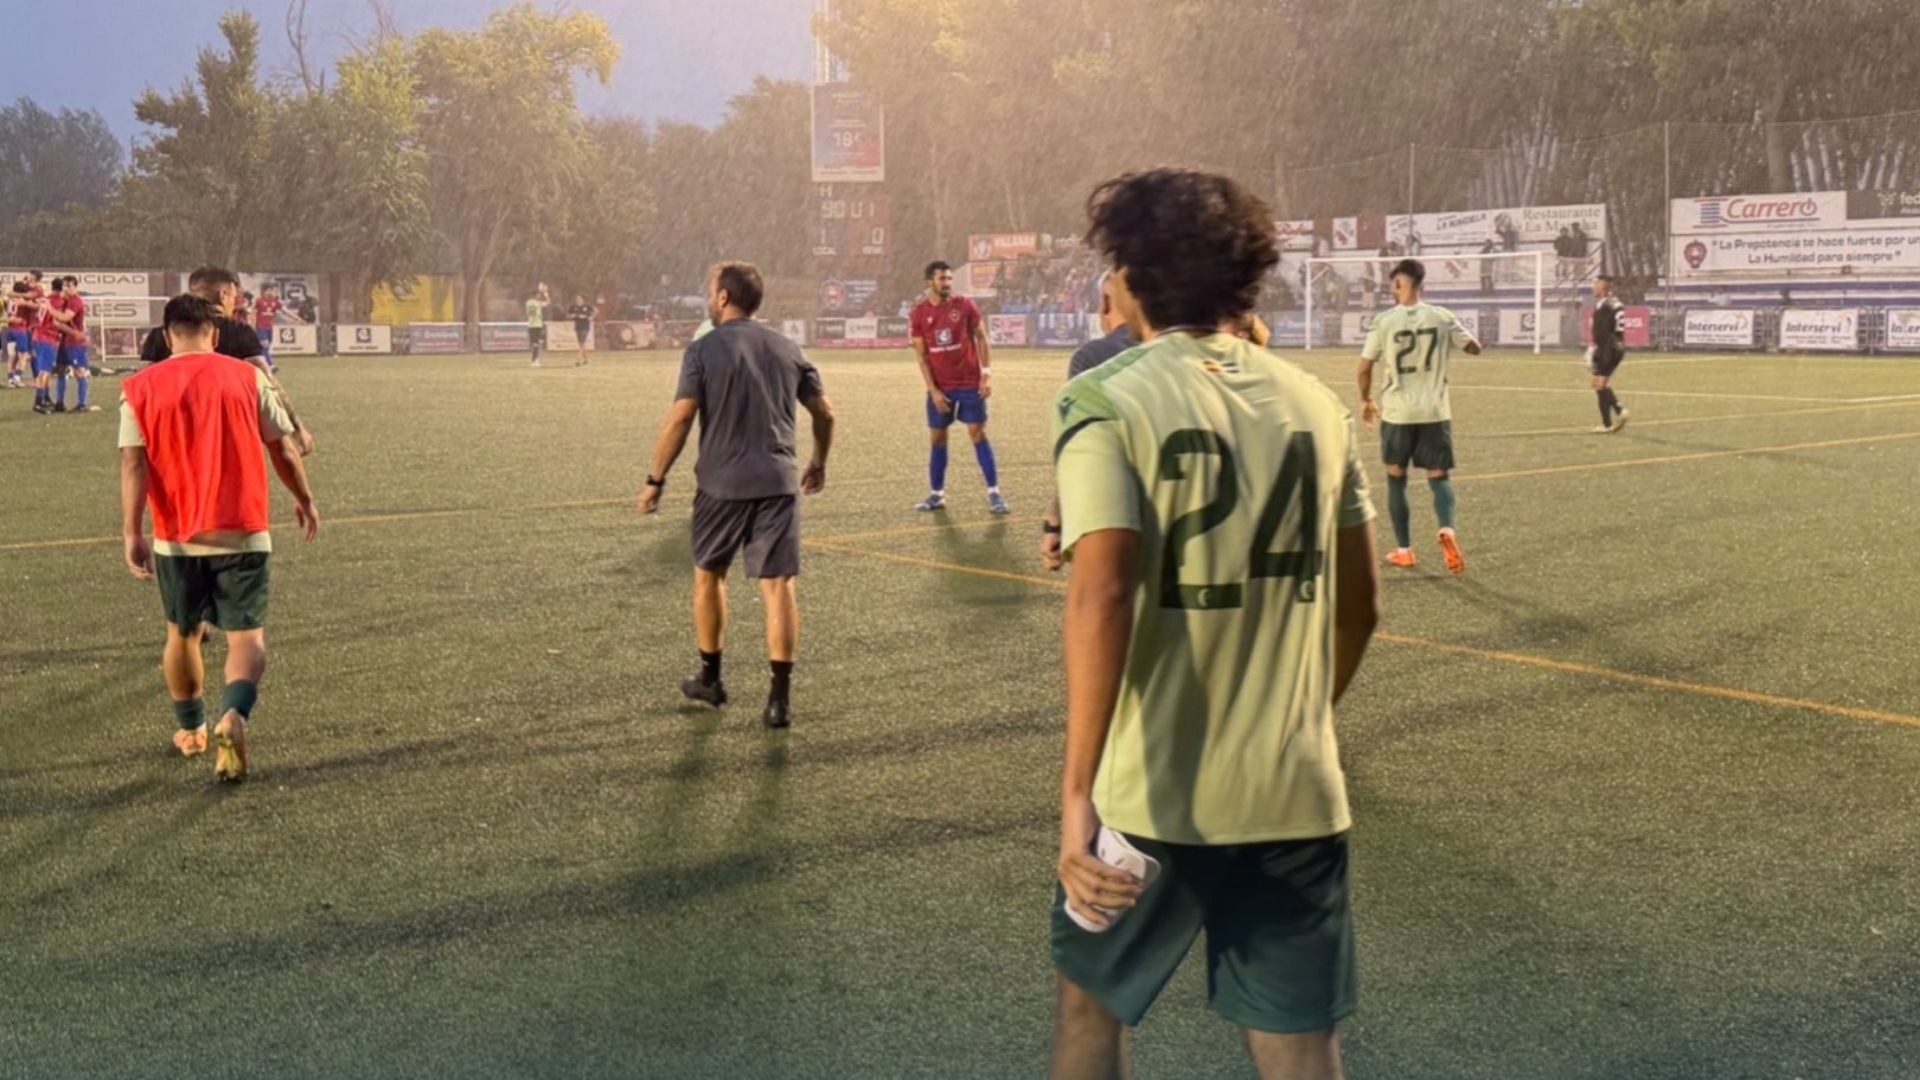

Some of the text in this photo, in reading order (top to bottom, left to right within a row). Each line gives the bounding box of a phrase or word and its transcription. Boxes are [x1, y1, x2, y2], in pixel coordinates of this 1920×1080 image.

[1522, 207, 1601, 221] Restaurante
[1727, 197, 1818, 219] Carrero
[1525, 220, 1542, 233] La
[1734, 239, 1800, 250] Prepotencia
[1803, 238, 1815, 247] te
[1817, 237, 1844, 247] hace
[1847, 236, 1882, 246] fuerte
[1885, 236, 1905, 248] por
[1748, 254, 1761, 263] La
[1763, 252, 1815, 263] Humildad
[1817, 254, 1844, 264] para
[1687, 321, 1739, 331] Interservi
[1785, 321, 1841, 333] Interservi
[1394, 327, 1438, 374] 27
[1159, 428, 1323, 609] 24
